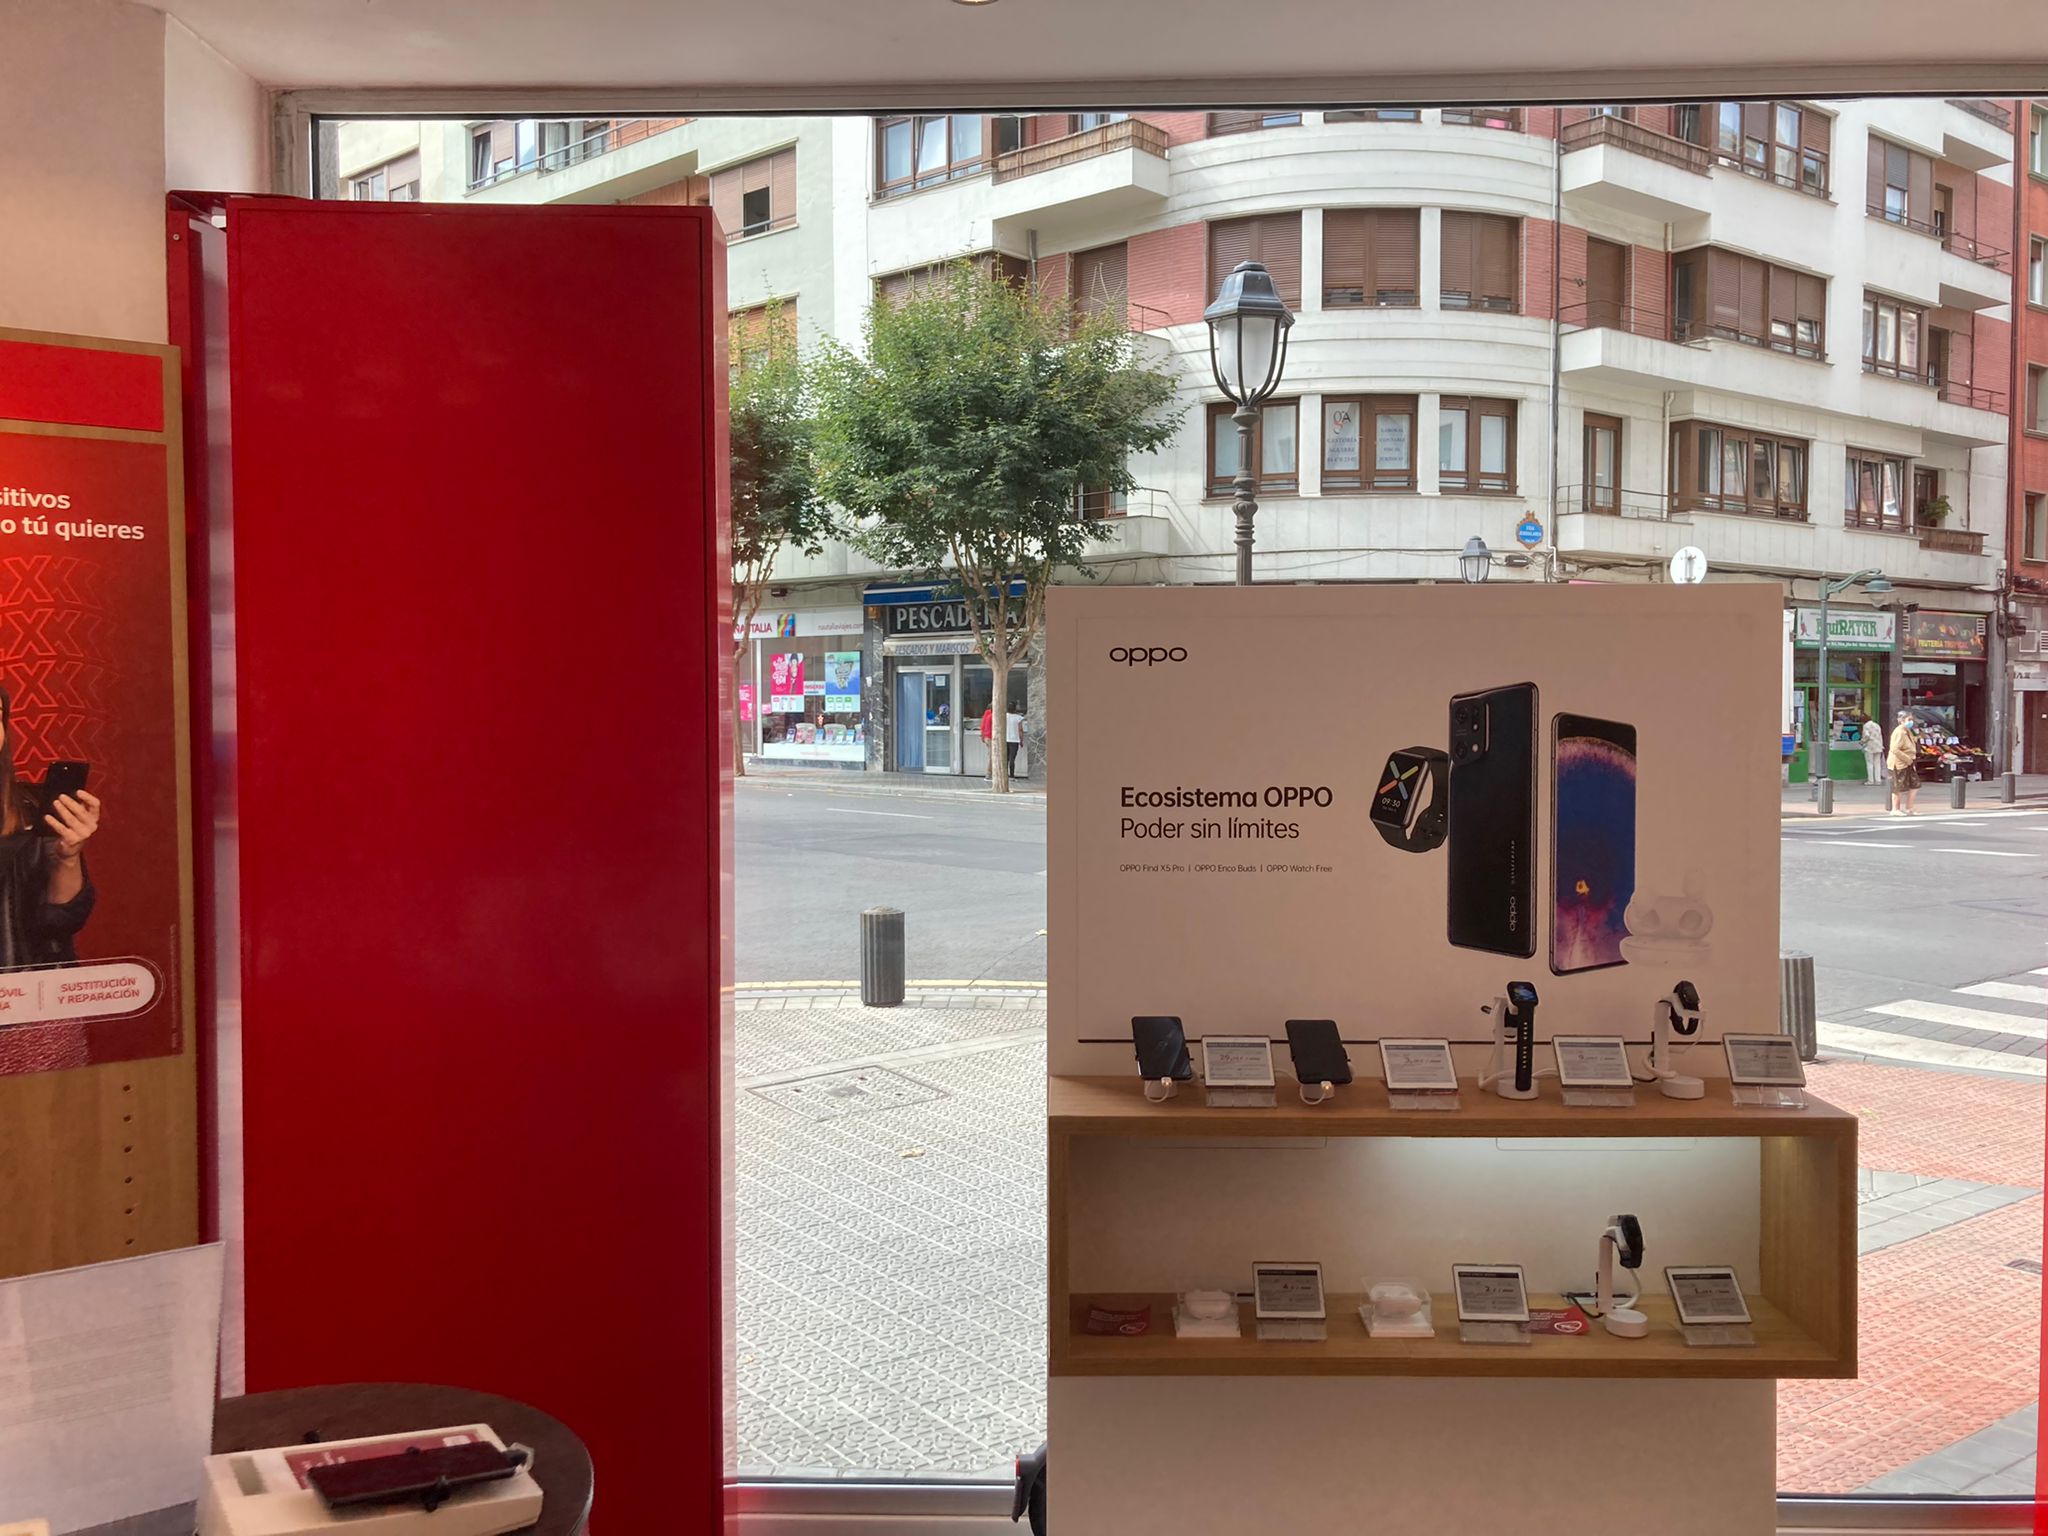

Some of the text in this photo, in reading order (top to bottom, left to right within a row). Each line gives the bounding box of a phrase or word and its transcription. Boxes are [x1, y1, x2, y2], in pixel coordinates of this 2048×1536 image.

[0, 486, 71, 510] itivos
[21, 515, 49, 535] tú
[55, 518, 145, 541] quieres
[895, 642, 969, 655] PESCADOS Y MARISCOS
[1121, 786, 1334, 808] Ecosistema OPPO
[1381, 797, 1401, 808] 09:30
[1121, 817, 1300, 839] Poder sin límites
[1120, 864, 1334, 872] OPPO Find X5 Pro OPPO Enco Buds OPPO Watch Free
[61, 977, 137, 993] SUSTITUCIÓN
[57, 988, 140, 1005] Y REPARACIÓN
